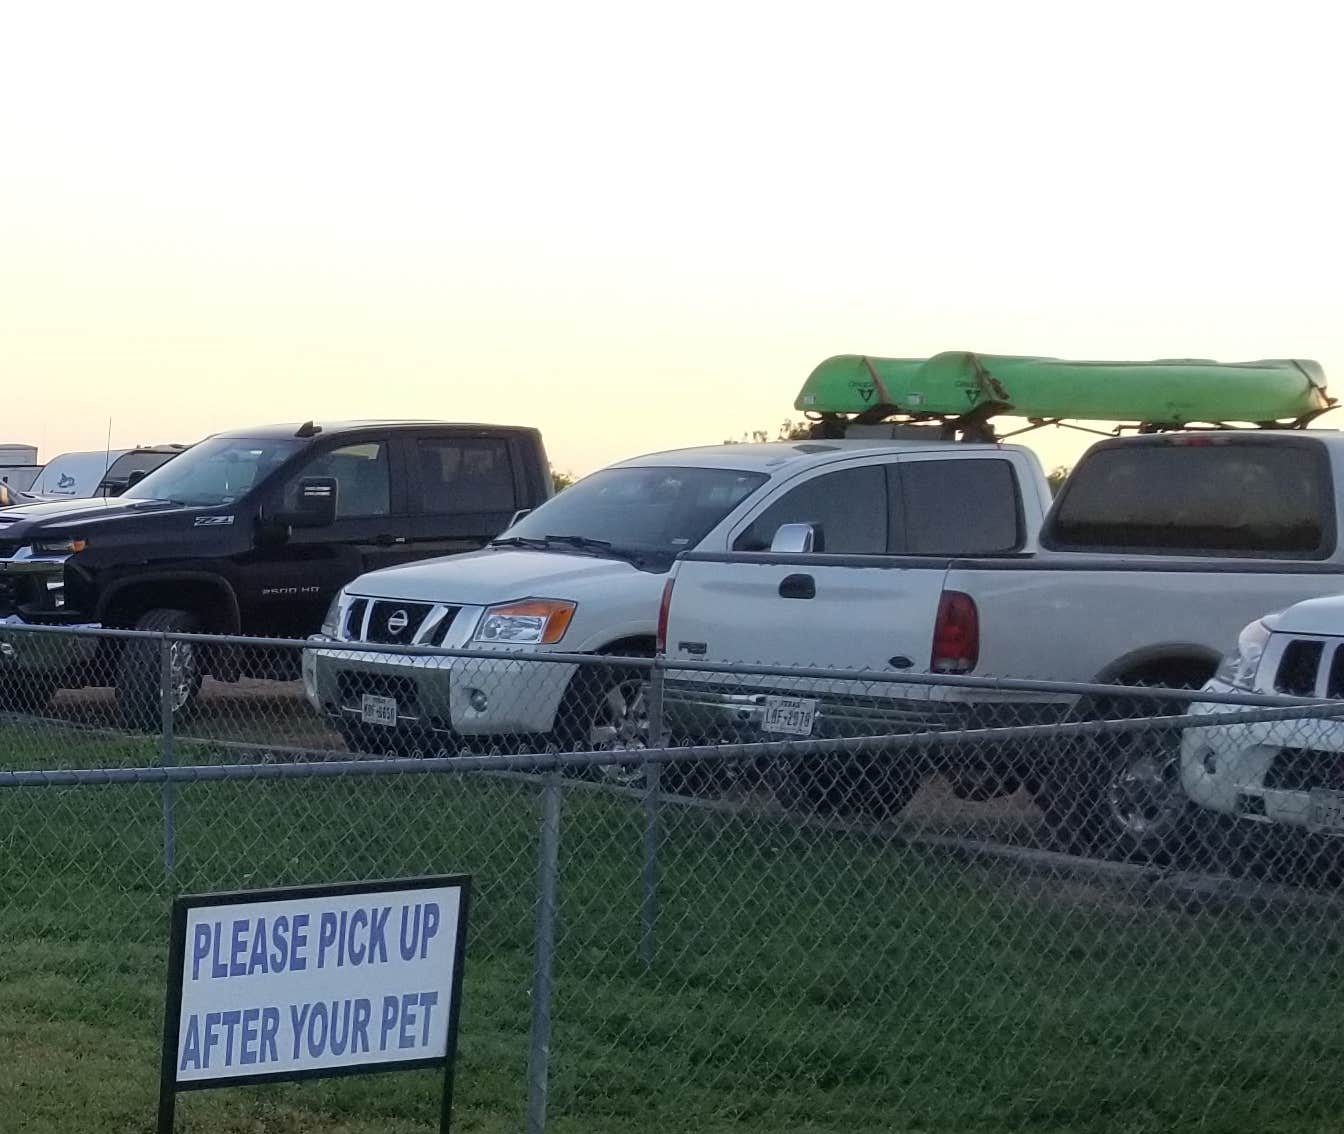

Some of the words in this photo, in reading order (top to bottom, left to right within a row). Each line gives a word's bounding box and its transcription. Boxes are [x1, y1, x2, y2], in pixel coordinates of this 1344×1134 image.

[191, 914, 310, 980] PLEASE
[317, 906, 392, 969] PICK
[399, 902, 440, 961] UP
[180, 1007, 280, 1071] AFTER
[289, 998, 371, 1060] YOUR
[379, 991, 438, 1051] PET
